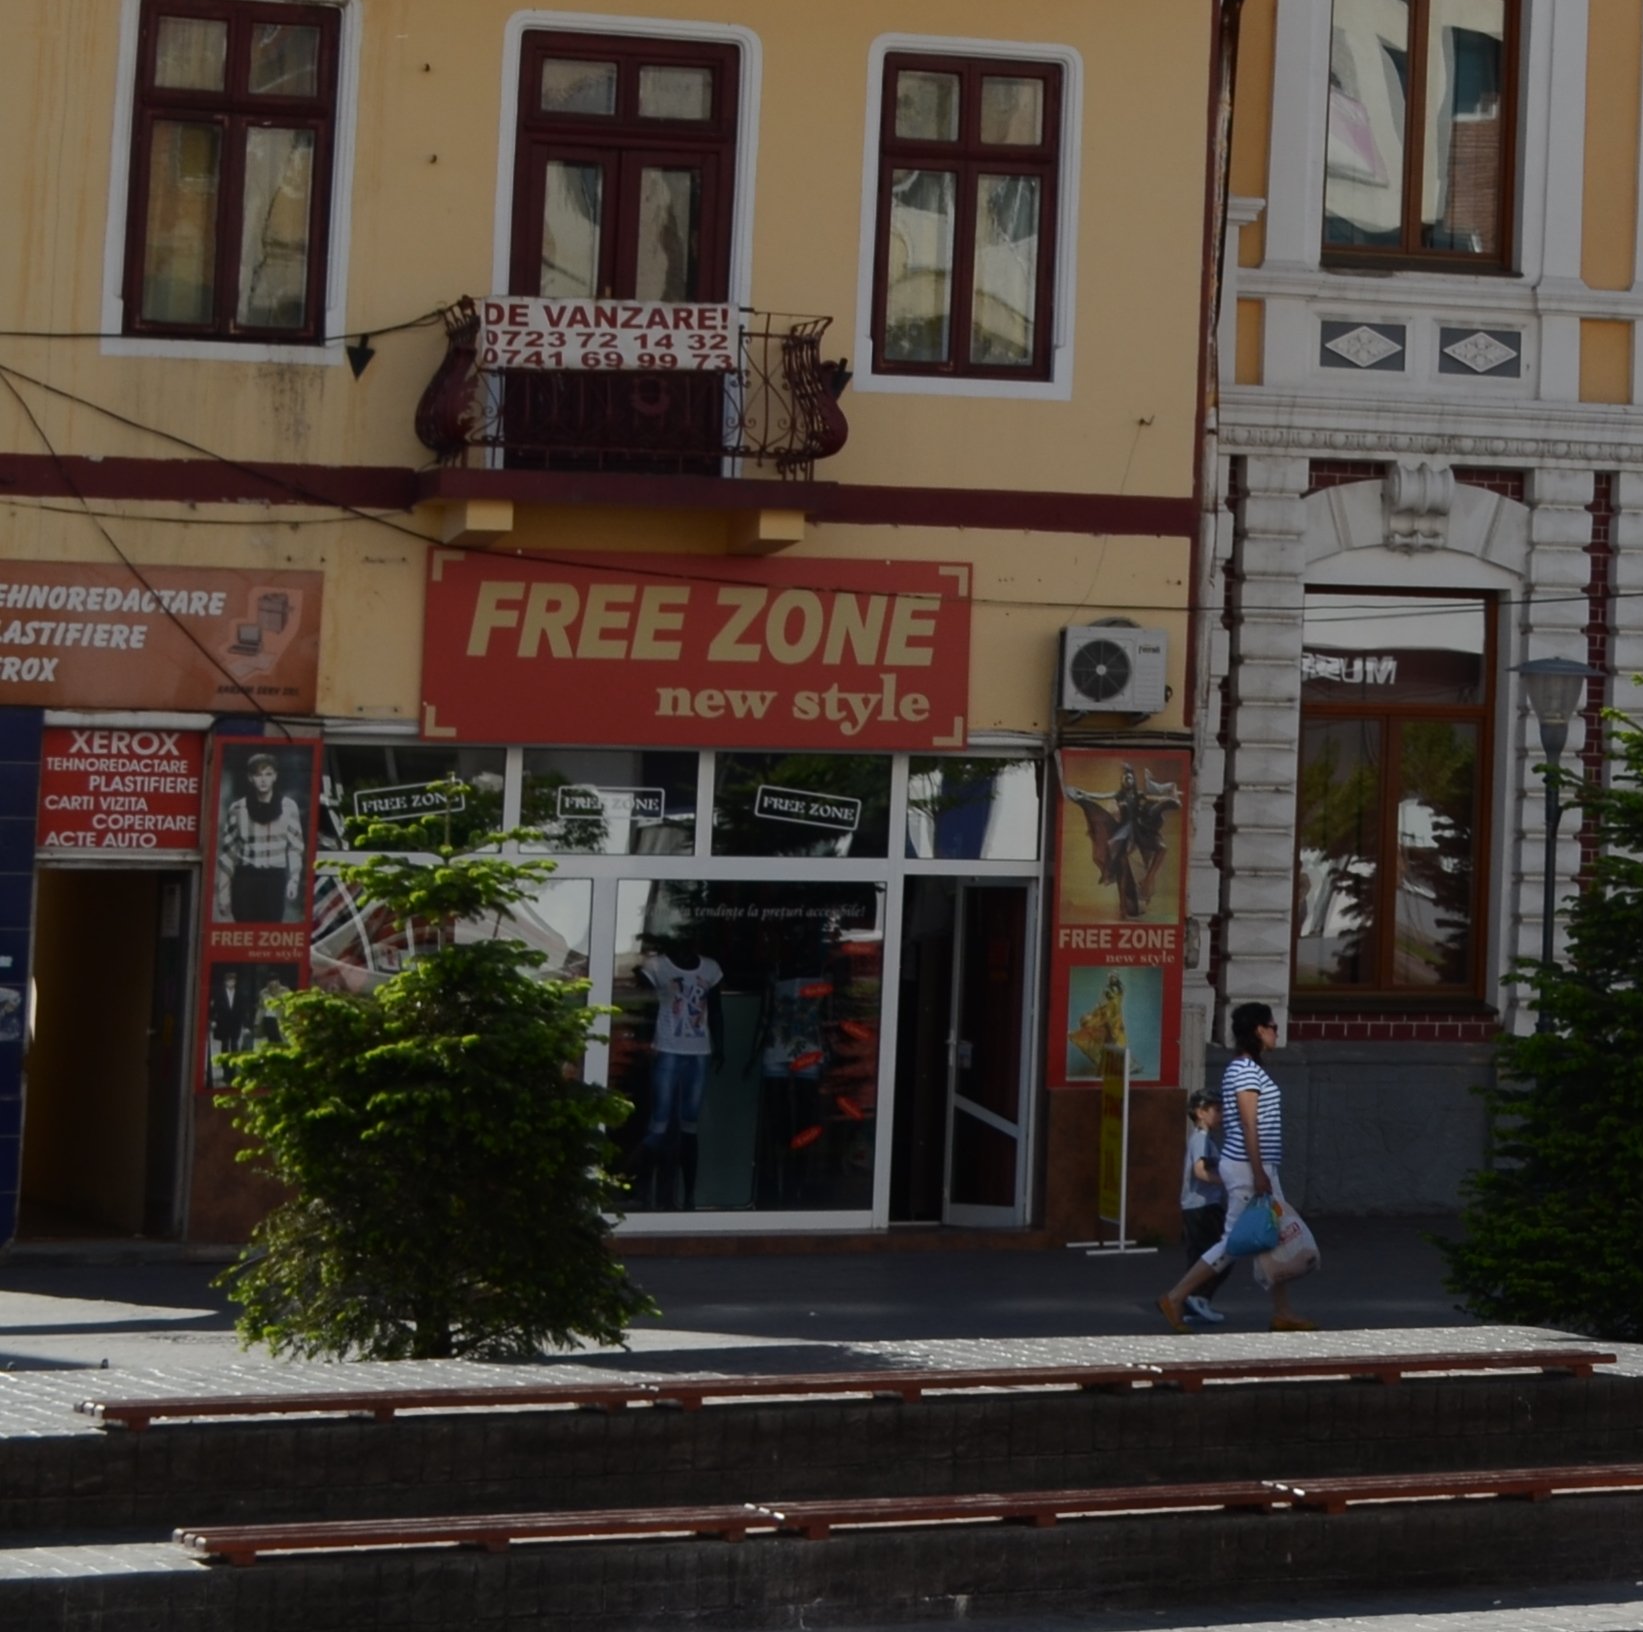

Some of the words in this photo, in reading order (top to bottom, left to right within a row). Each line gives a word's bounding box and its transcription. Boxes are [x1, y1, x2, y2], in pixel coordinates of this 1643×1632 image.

[485, 302, 529, 327] DE
[543, 305, 729, 330] VANZARE!
[486, 330, 567, 348] 0723
[576, 332, 618, 349] 72
[633, 333, 674, 349] 14
[687, 333, 728, 350] 32
[483, 348, 563, 367] 0741
[581, 350, 624, 368] 69
[636, 352, 678, 369] 99
[692, 353, 732, 371] 73
[467, 580, 691, 662] FREE
[708, 585, 942, 667] ZONE
[0, 620, 148, 649] ASTIFIERE
[0, 656, 59, 682] ROX
[655, 686, 779, 720] new
[792, 673, 931, 735] style
[69, 730, 180, 756] XEROX
[47, 757, 188, 774] TEHNOREDACTARE
[88, 776, 198, 794] PLASTIFIERE
[45, 795, 94, 811] CARTI
[99, 796, 148, 812] VIZITA
[362, 796, 408, 813] FREE
[411, 792, 459, 808] ZON
[762, 795, 806, 813] FREE
[809, 803, 855, 821] ZONE
[92, 813, 197, 832] COPERTARE
[44, 831, 97, 848] ACTE
[102, 831, 158, 849] AUTO
[211, 930, 254, 947] FREE
[258, 931, 305, 947] ZONE
[1058, 928, 1113, 949] FREE
[1118, 928, 1176, 949] ZONE
[1105, 953, 1136, 963] new
[1140, 950, 1176, 967] style
